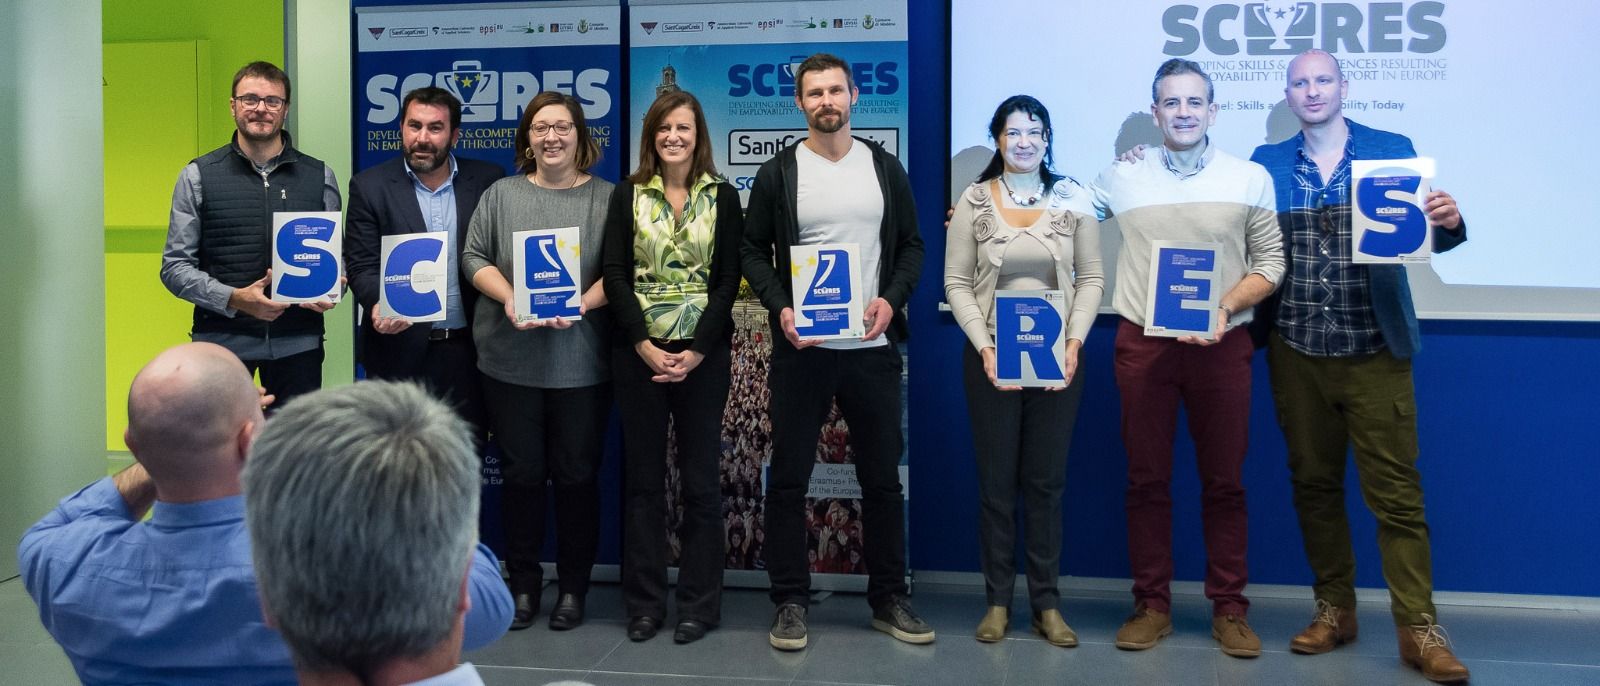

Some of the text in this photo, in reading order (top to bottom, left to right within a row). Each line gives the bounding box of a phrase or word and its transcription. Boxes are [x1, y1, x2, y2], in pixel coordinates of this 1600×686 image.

[1238, 59, 1275, 70] SKILLS
[1277, 60, 1286, 69] &
[1381, 58, 1447, 69] RESULTING
[1382, 71, 1397, 81] IN
[1400, 70, 1447, 81] EUROPE
[859, 99, 900, 108] RESULTING
[1237, 100, 1265, 111] Skills
[1372, 100, 1405, 112] Today
[871, 107, 900, 115] EUROPE
[466, 128, 476, 139] &
[367, 141, 380, 151] IN
